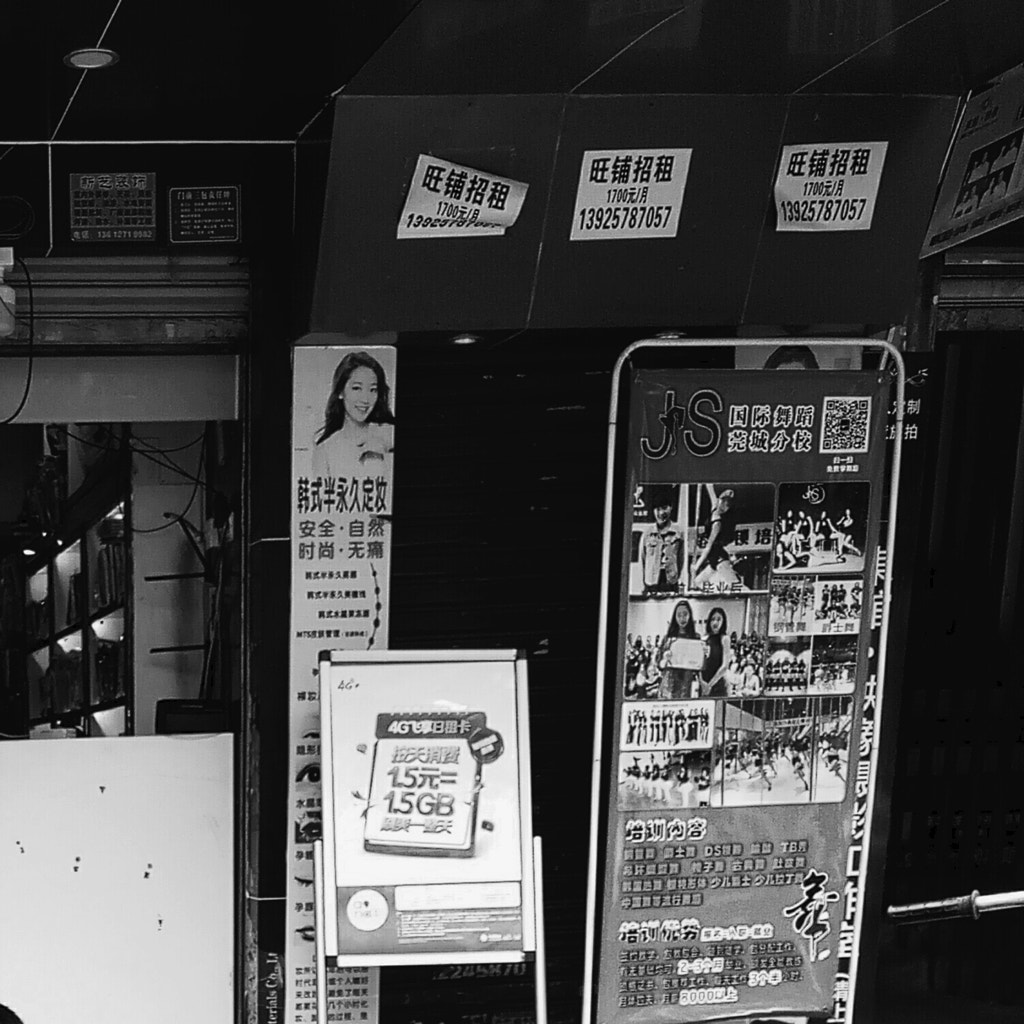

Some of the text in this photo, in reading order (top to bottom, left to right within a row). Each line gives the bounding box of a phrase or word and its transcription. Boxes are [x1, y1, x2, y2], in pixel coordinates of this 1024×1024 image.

[589, 155, 675, 184] 旺铺招租
[786, 149, 871, 177] 旺铺招租
[421, 164, 511, 211] 旺铺招租
[607, 186, 649, 204] 1700元/月
[803, 179, 844, 197] 1700元/月
[436, 201, 480, 223] 1700元/月
[579, 206, 672, 230] 13925787057
[781, 198, 867, 222] 13925787057
[640, 389, 722, 460] JS
[729, 405, 815, 428] 国际舞蹈
[727, 430, 812, 453] 莞城分校
[297, 476, 387, 514] 韩式半永久定妆
[626, 818, 707, 842] 培训内容
[619, 918, 700, 943] 培训优势
